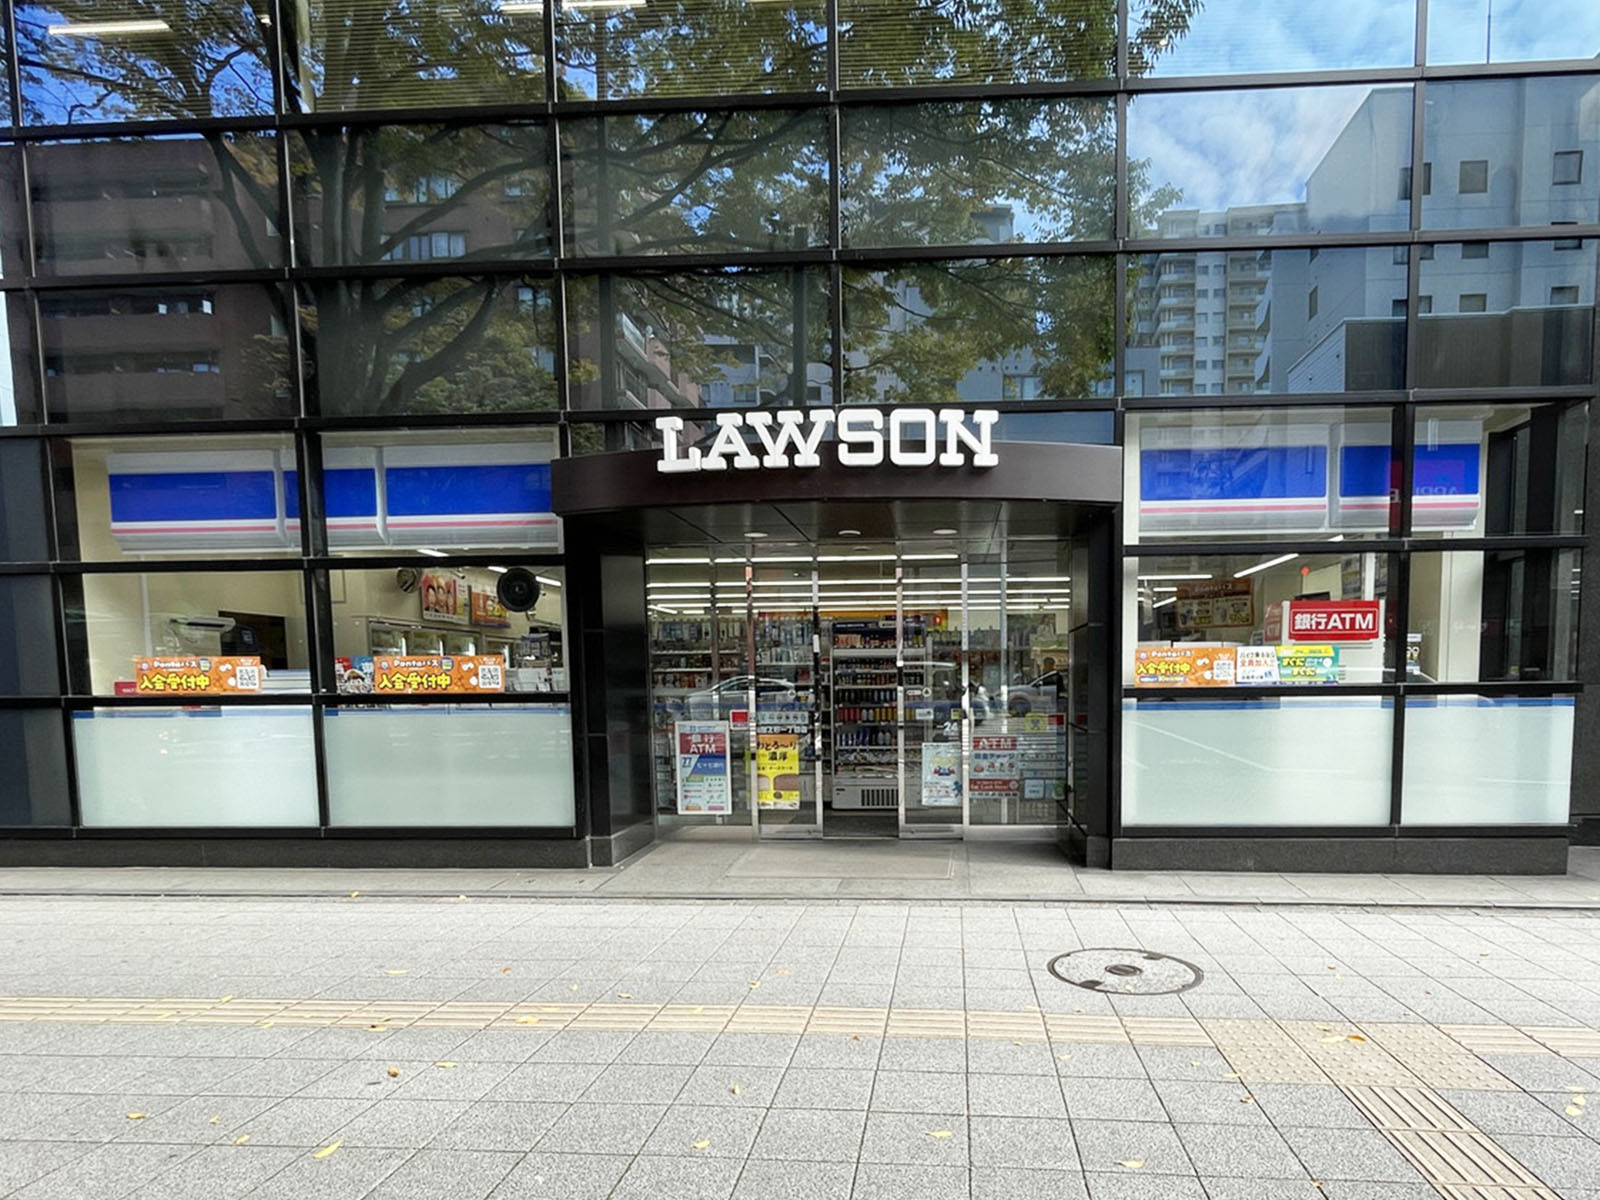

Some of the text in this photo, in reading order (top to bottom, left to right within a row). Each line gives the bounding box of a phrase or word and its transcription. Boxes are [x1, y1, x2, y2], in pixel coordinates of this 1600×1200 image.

[656, 408, 999, 473] LAWSON
[1294, 613, 1373, 630] 銀行ATM
[378, 672, 451, 689] 入会受付中
[689, 744, 716, 754] ATM
[981, 738, 1011, 748] ATM
